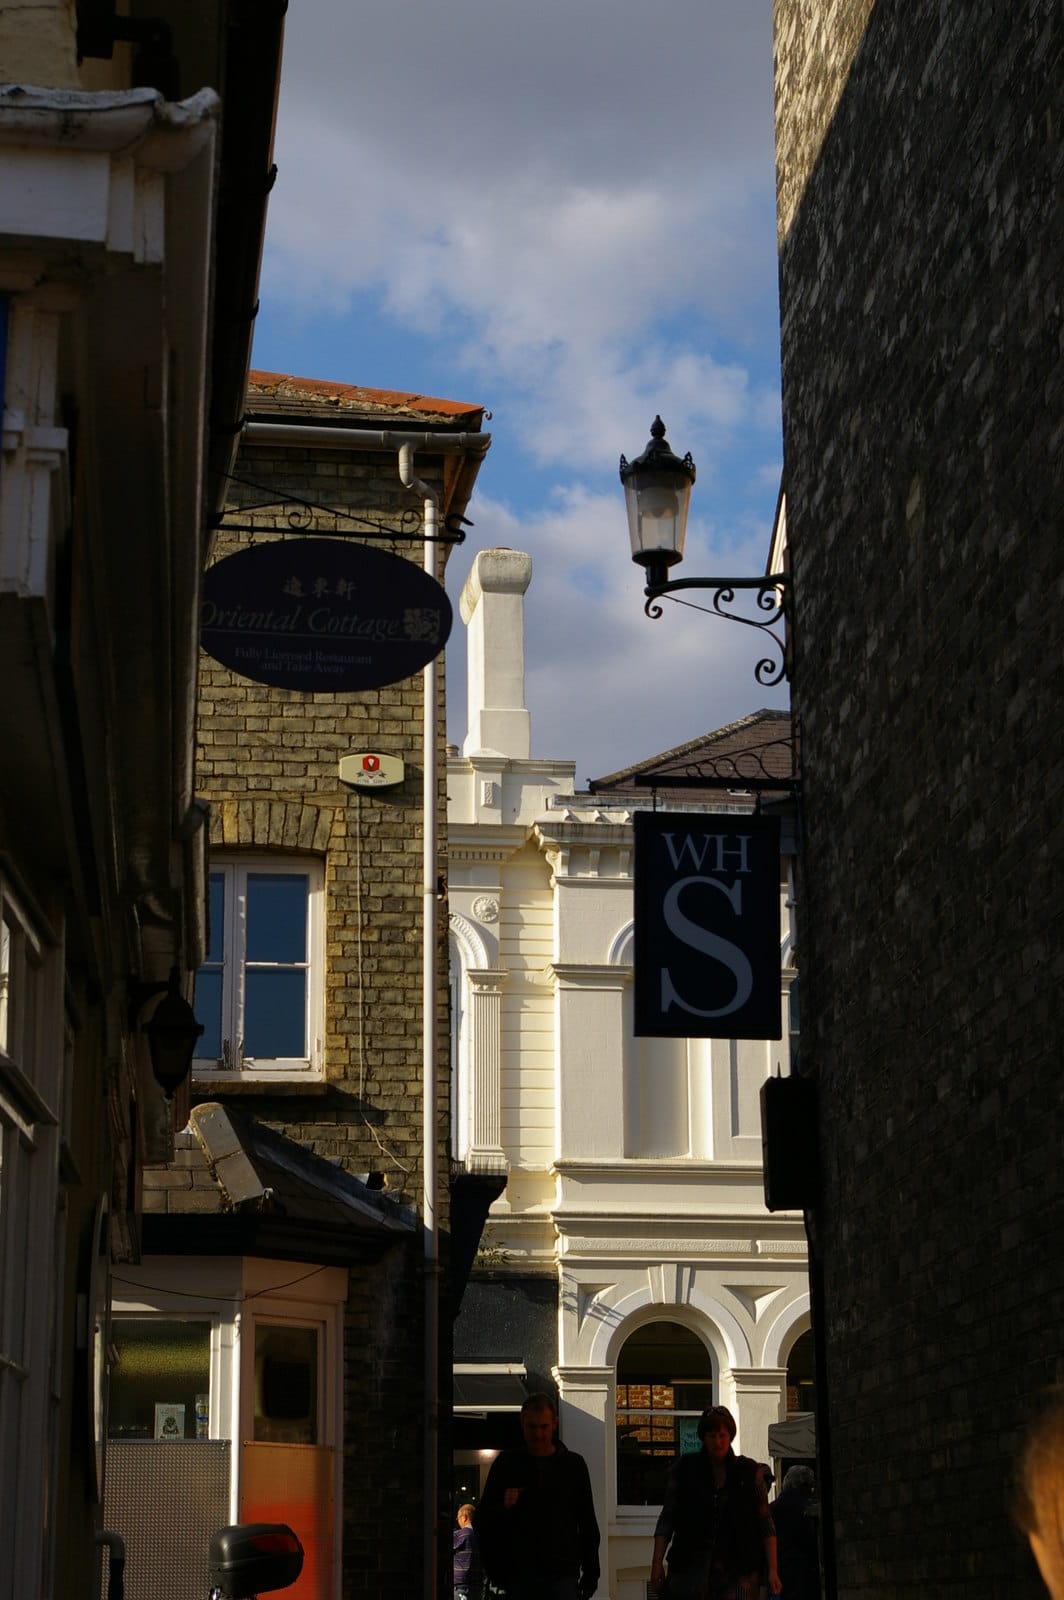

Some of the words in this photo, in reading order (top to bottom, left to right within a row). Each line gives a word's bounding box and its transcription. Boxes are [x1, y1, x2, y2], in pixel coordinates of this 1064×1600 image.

[200, 602, 302, 630] Oriental
[310, 607, 399, 641] Cottage
[234, 647, 262, 662] Fully
[264, 648, 312, 662] Licensed
[315, 650, 372, 664] Restaurant
[262, 661, 282, 671] and
[286, 661, 312, 672] Take
[314, 662, 346, 677] Away
[661, 833, 752, 872] WH
[661, 875, 753, 1017] S
